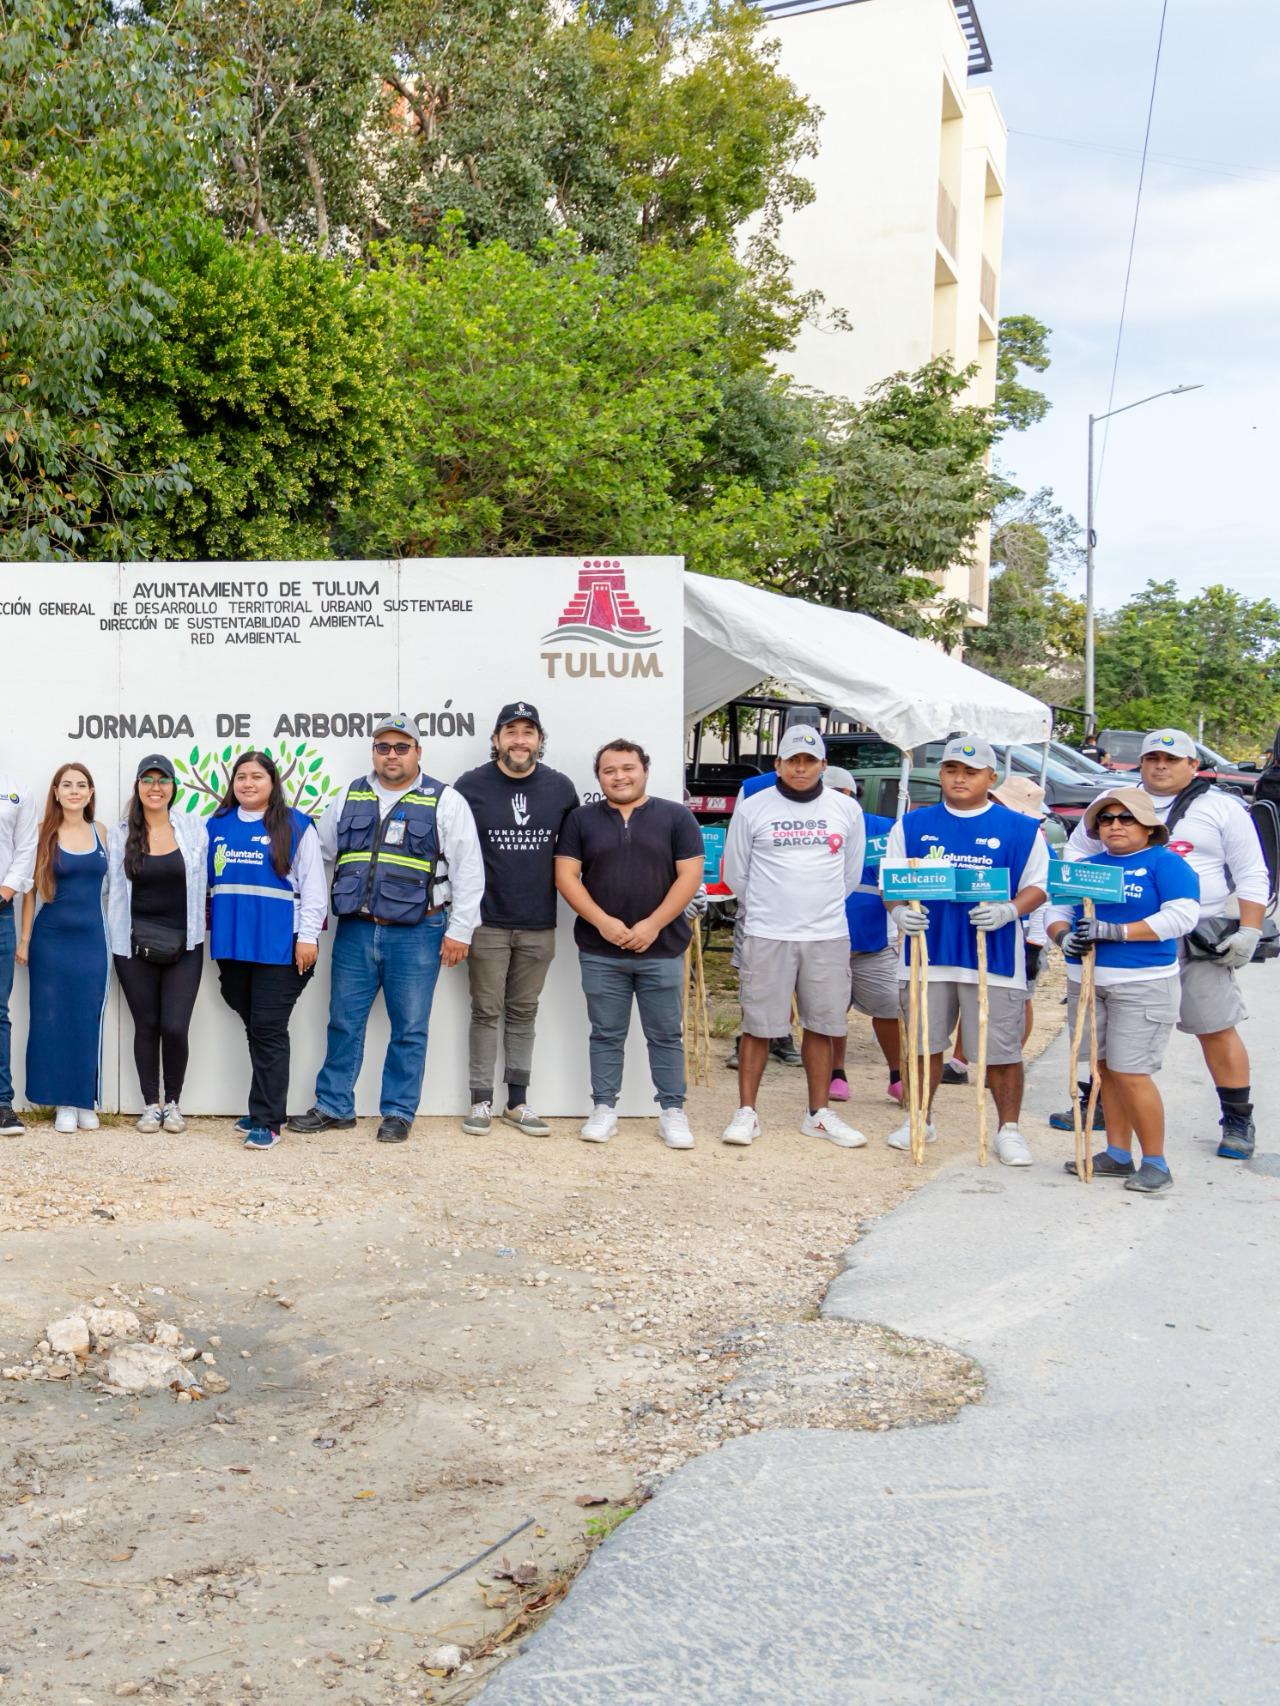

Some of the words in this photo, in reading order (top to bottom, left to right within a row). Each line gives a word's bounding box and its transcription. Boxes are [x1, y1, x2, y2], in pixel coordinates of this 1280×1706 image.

[132, 581, 268, 599] AYUNTAMIENTO
[279, 581, 302, 597] DE
[312, 580, 380, 597] TULUM
[38, 602, 96, 616] GENERAL
[113, 602, 128, 615] DE
[135, 601, 218, 615] DESARROLLO
[228, 600, 312, 614] TERRITORIAL
[321, 600, 373, 613] URBANO
[383, 599, 473, 612] SUSTENTABLE
[99, 615, 157, 631] DIRECCIÓN
[164, 618, 180, 629] DE
[186, 616, 301, 629] SUSTENTABILIDAD
[309, 615, 384, 628] AMBIENTAL
[191, 632, 215, 645] RED
[225, 631, 302, 645] AMBIENTAL
[540, 652, 664, 679] TULUM
[68, 713, 195, 739] JORNADA
[216, 713, 251, 738] DE
[274, 699, 476, 738] ARBORICIÓN
[488, 828, 552, 836] FUNDACIÓN
[771, 819, 828, 831] TOD@S
[772, 830, 814, 838] CONTRA
[891, 872, 947, 884] Relicario
